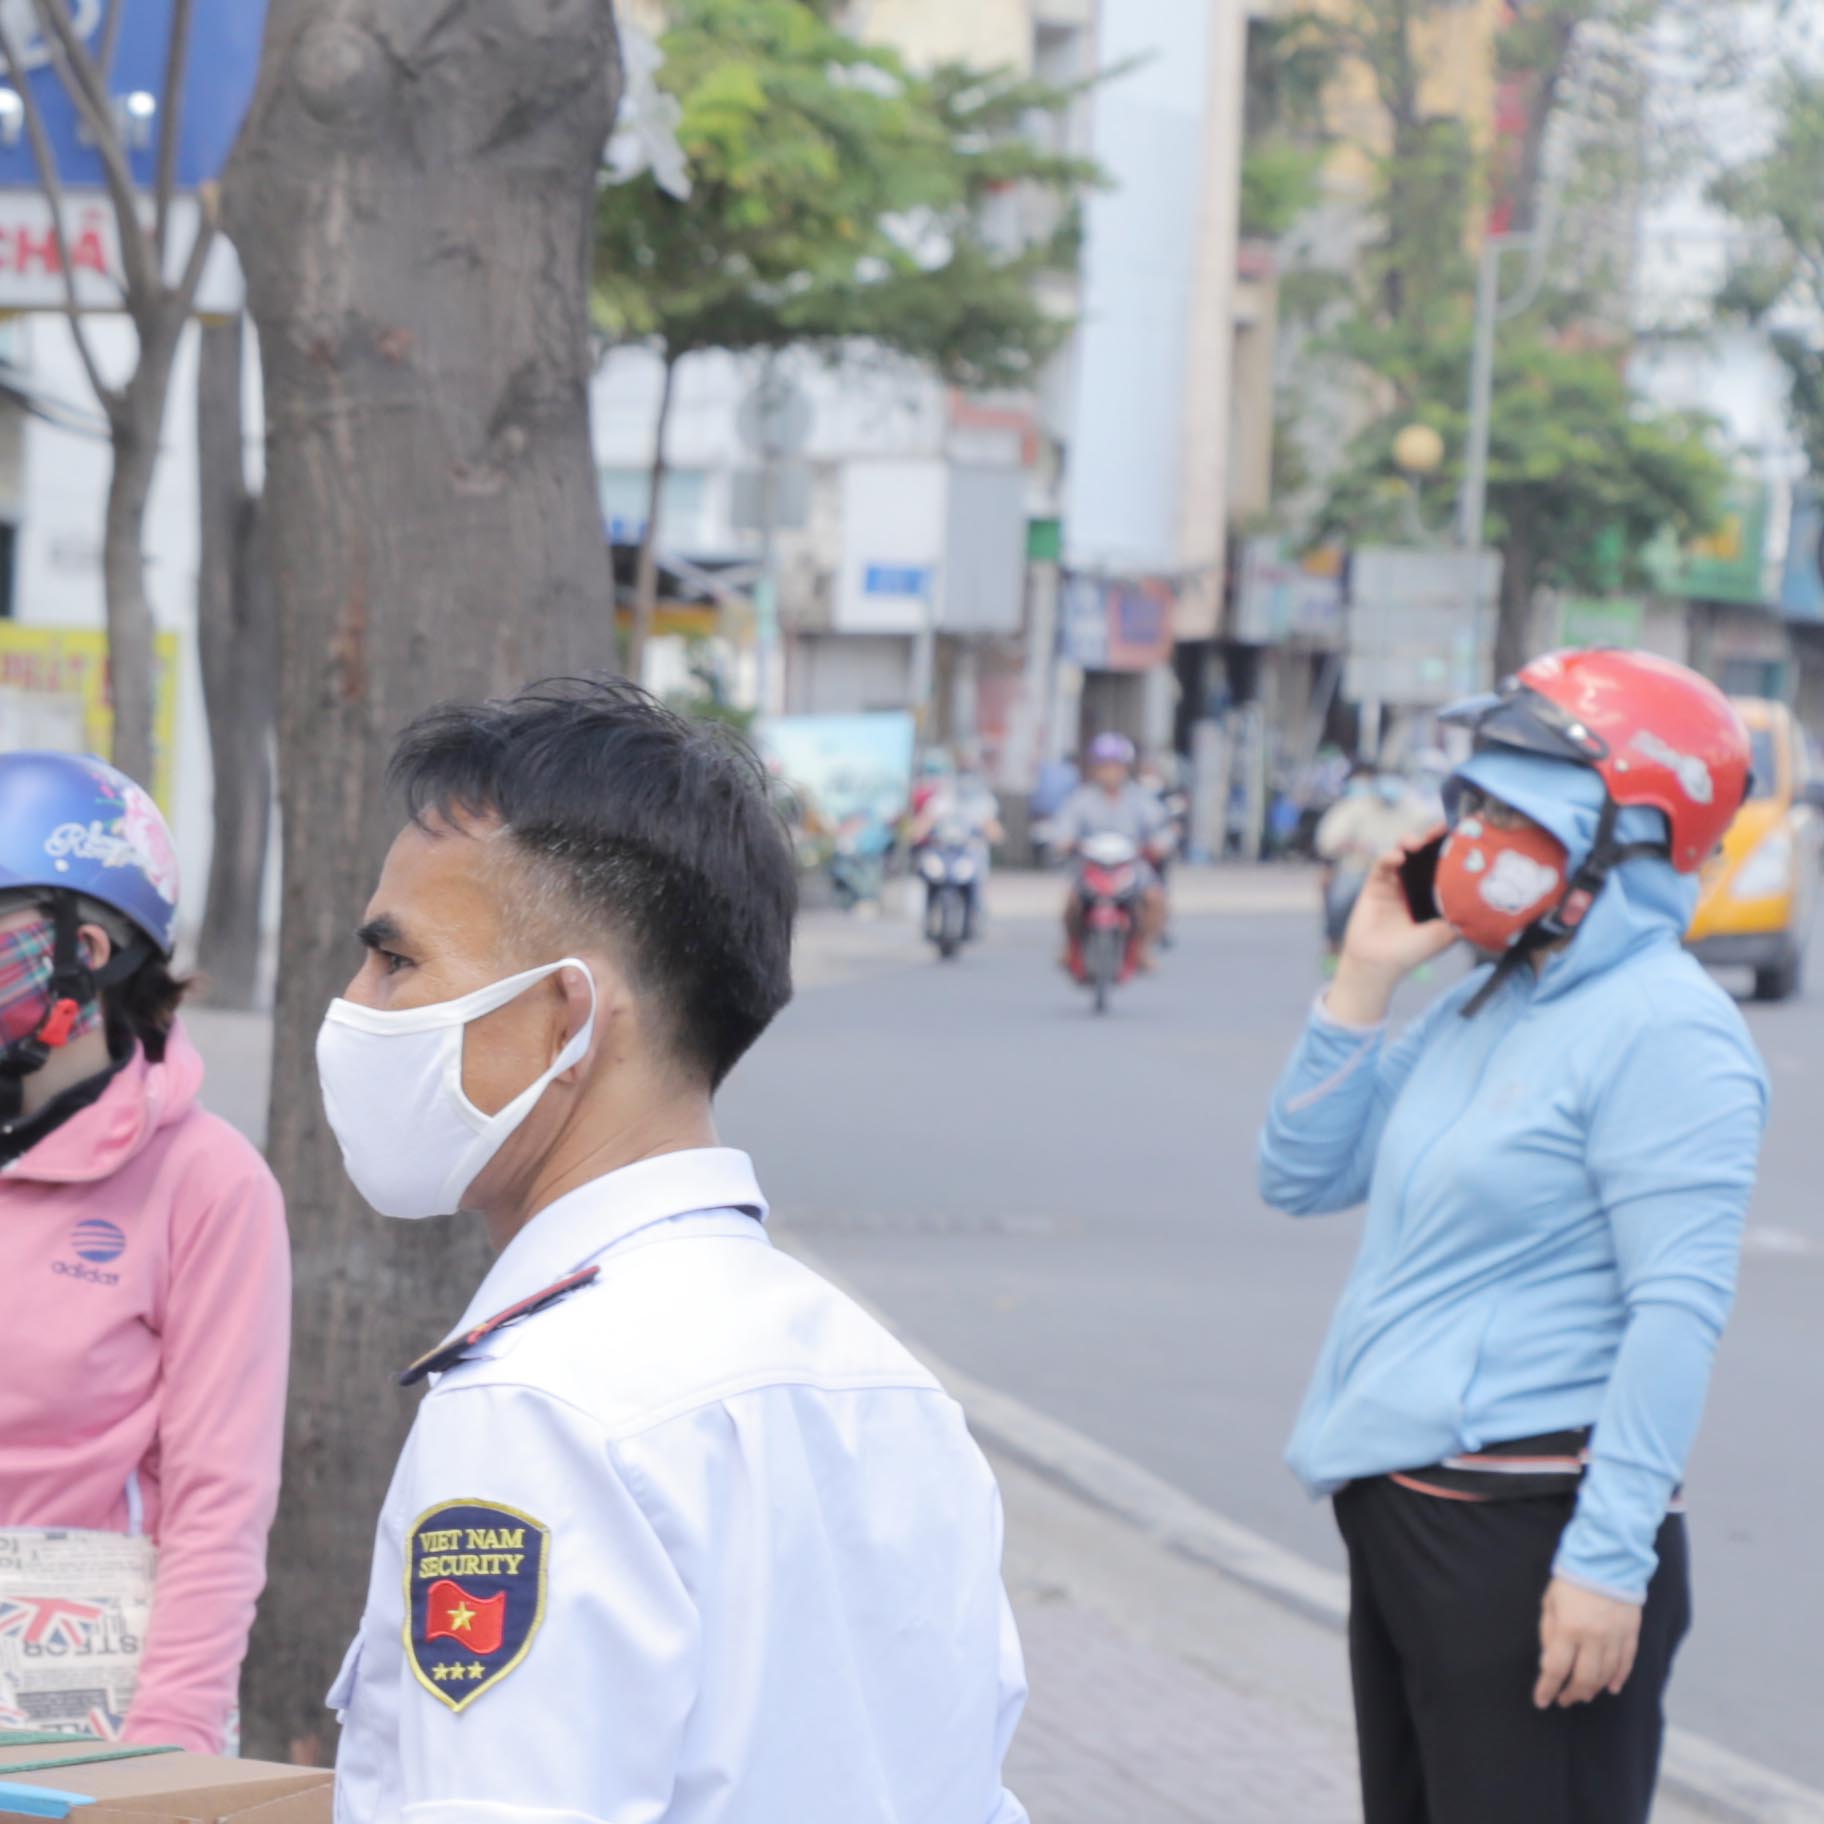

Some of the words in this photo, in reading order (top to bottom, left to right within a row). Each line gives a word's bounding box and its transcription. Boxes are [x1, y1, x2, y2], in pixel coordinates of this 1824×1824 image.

[418, 1529, 463, 1553] VIET
[465, 1528, 526, 1550] NAM
[418, 1553, 526, 1579] SECURITY
